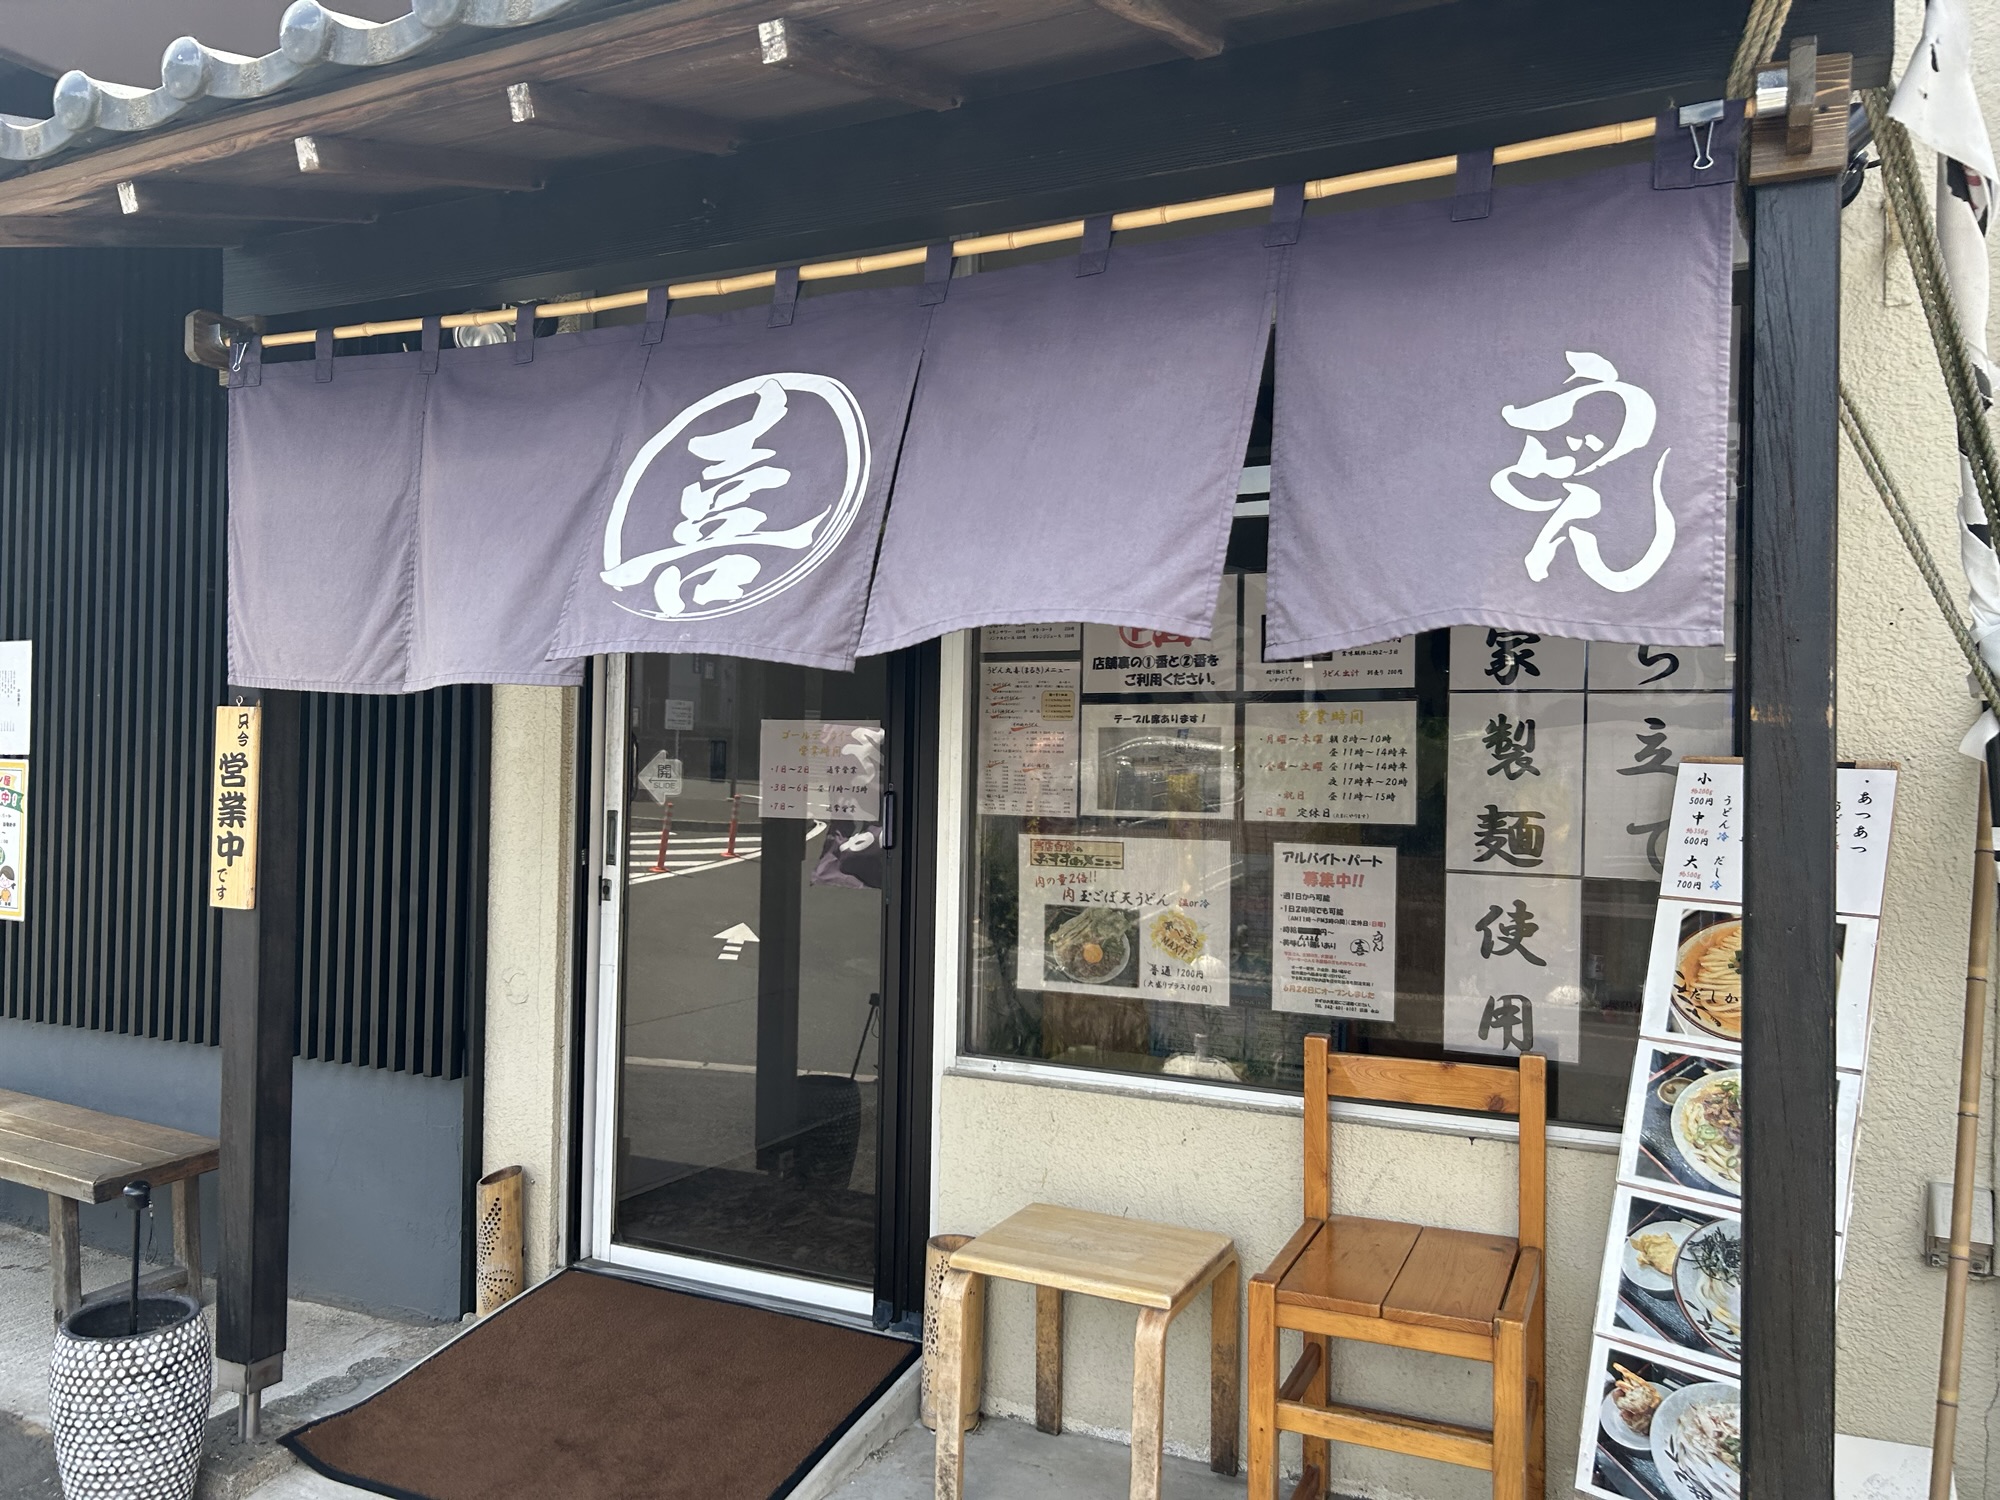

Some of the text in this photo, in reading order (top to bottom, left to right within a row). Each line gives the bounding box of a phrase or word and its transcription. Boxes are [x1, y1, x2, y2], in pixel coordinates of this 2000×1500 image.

[1490, 351, 1677, 593] うどん
[600, 374, 850, 618] 喜
[1092, 654, 1219, 670] 店舗裏の①番と②番を
[1124, 673, 1216, 687] ご利用ください。
[1296, 708, 1365, 726] 営業時間
[1328, 734, 1340, 745] 朝
[1342, 733, 1393, 745] 8時〜10時
[1342, 747, 1409, 758] 11時〜14時半
[657, 764, 672, 779] 開
[1342, 761, 1409, 772] 11時〜14時半
[653, 781, 677, 790] SLIDE
[1327, 776, 1409, 788] 夜 17時半〜20時
[1697, 772, 1712, 785] 小
[1342, 790, 1397, 802] 11時〜15時
[1688, 796, 1714, 807] 500円
[1296, 807, 1331, 819] 定休日
[1692, 811, 1706, 825] 中
[1683, 836, 1709, 847] 600円
[1033, 852, 1122, 867] おすすめメニュー
[1282, 850, 1383, 868] アルバイト・パート
[1683, 855, 1698, 869] 大
[1676, 880, 1702, 891] 700円
[1149, 963, 1205, 980] 普通 1200円
[1282, 984, 1376, 1000] 6月24日にオープンしました
